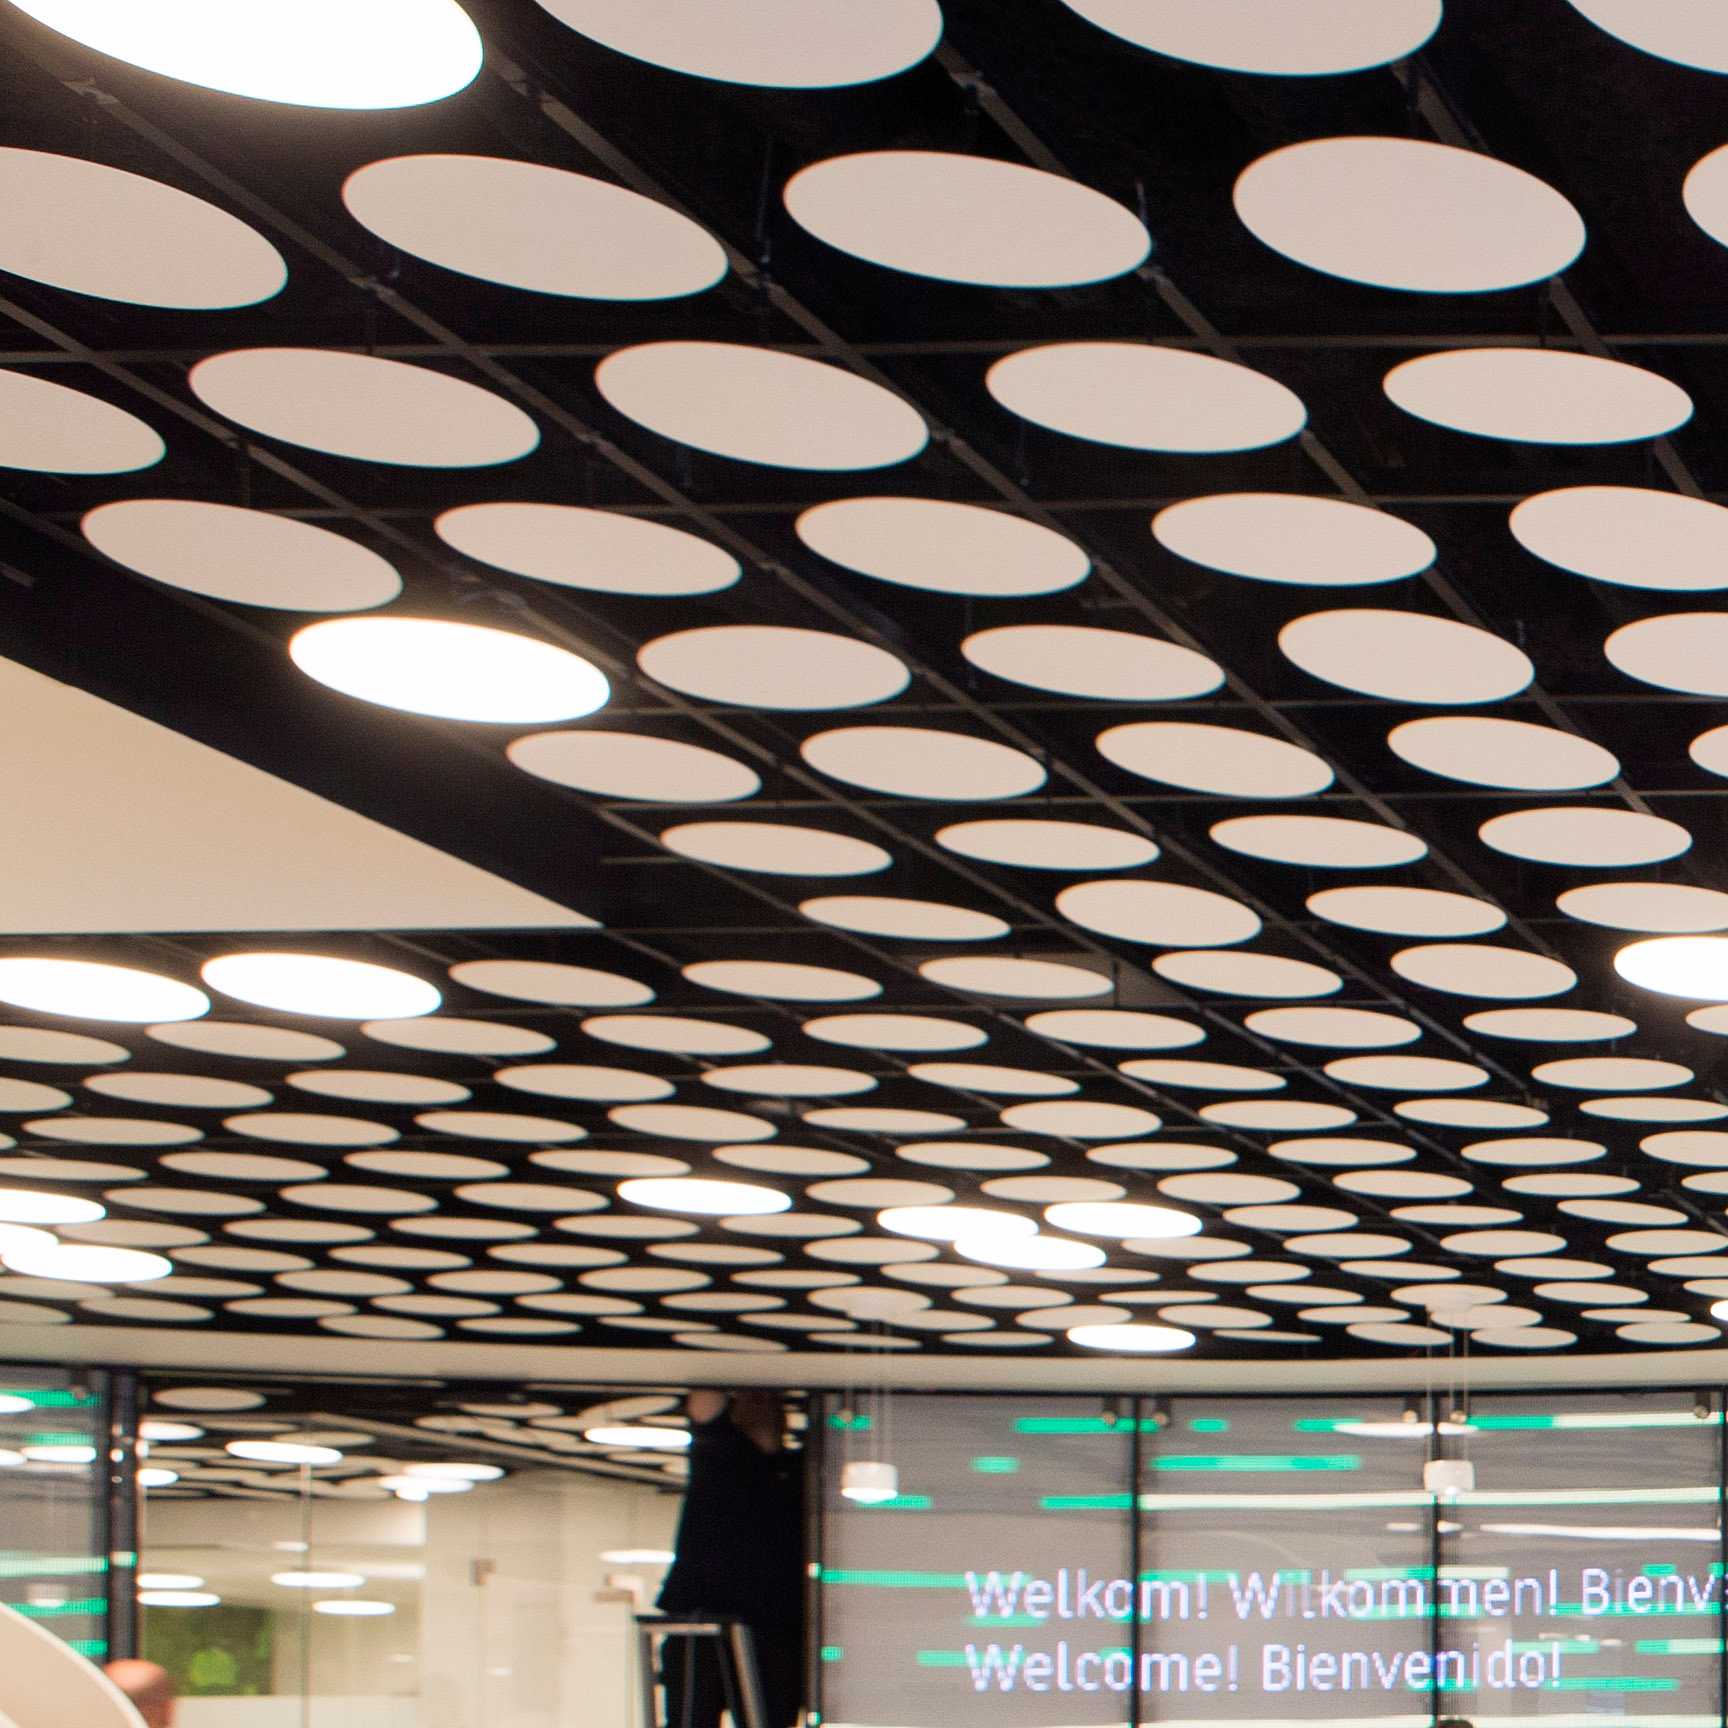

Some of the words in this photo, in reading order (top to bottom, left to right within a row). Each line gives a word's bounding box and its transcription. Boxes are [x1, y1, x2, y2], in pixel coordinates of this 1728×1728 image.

[964, 1567, 1208, 1619] Welkom!
[964, 1640, 1240, 1692] Welcome!
[1262, 1637, 1562, 1691] Bienvenido!
